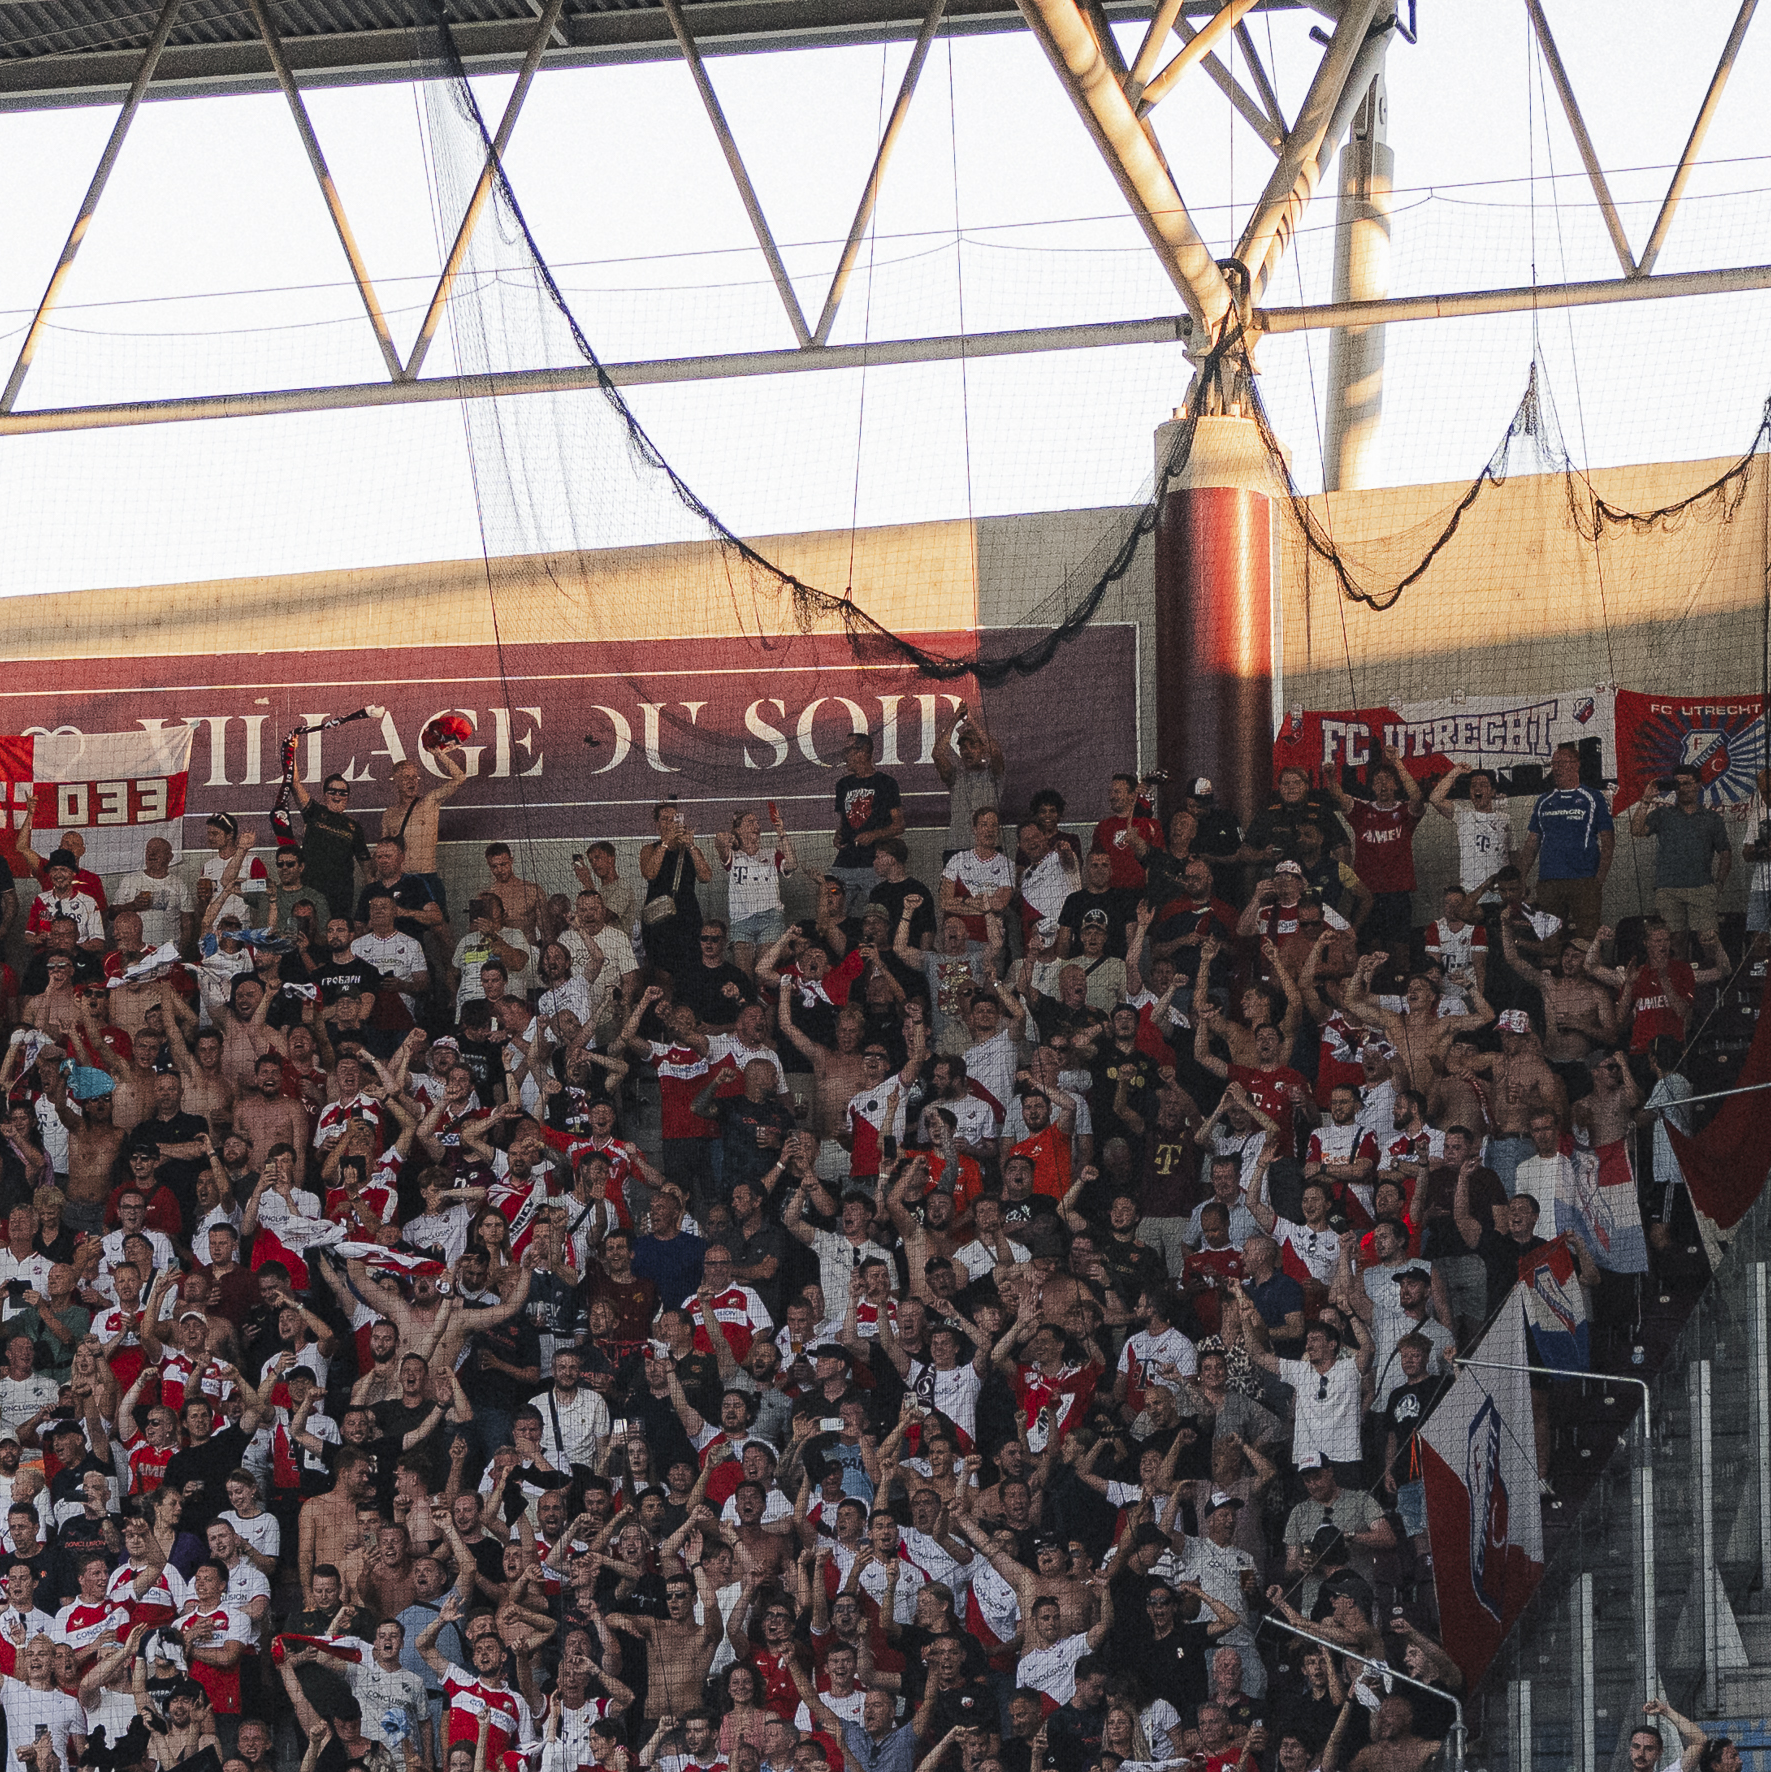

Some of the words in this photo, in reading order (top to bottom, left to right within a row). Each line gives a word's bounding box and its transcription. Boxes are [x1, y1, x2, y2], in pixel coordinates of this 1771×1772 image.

[590, 701, 708, 775] DU
[1322, 718, 1372, 767] FC
[1383, 700, 1558, 757] UTRECHT
[1650, 703, 1676, 716] FC
[1681, 703, 1762, 717] UTRECHT
[58, 778, 168, 827] 033
